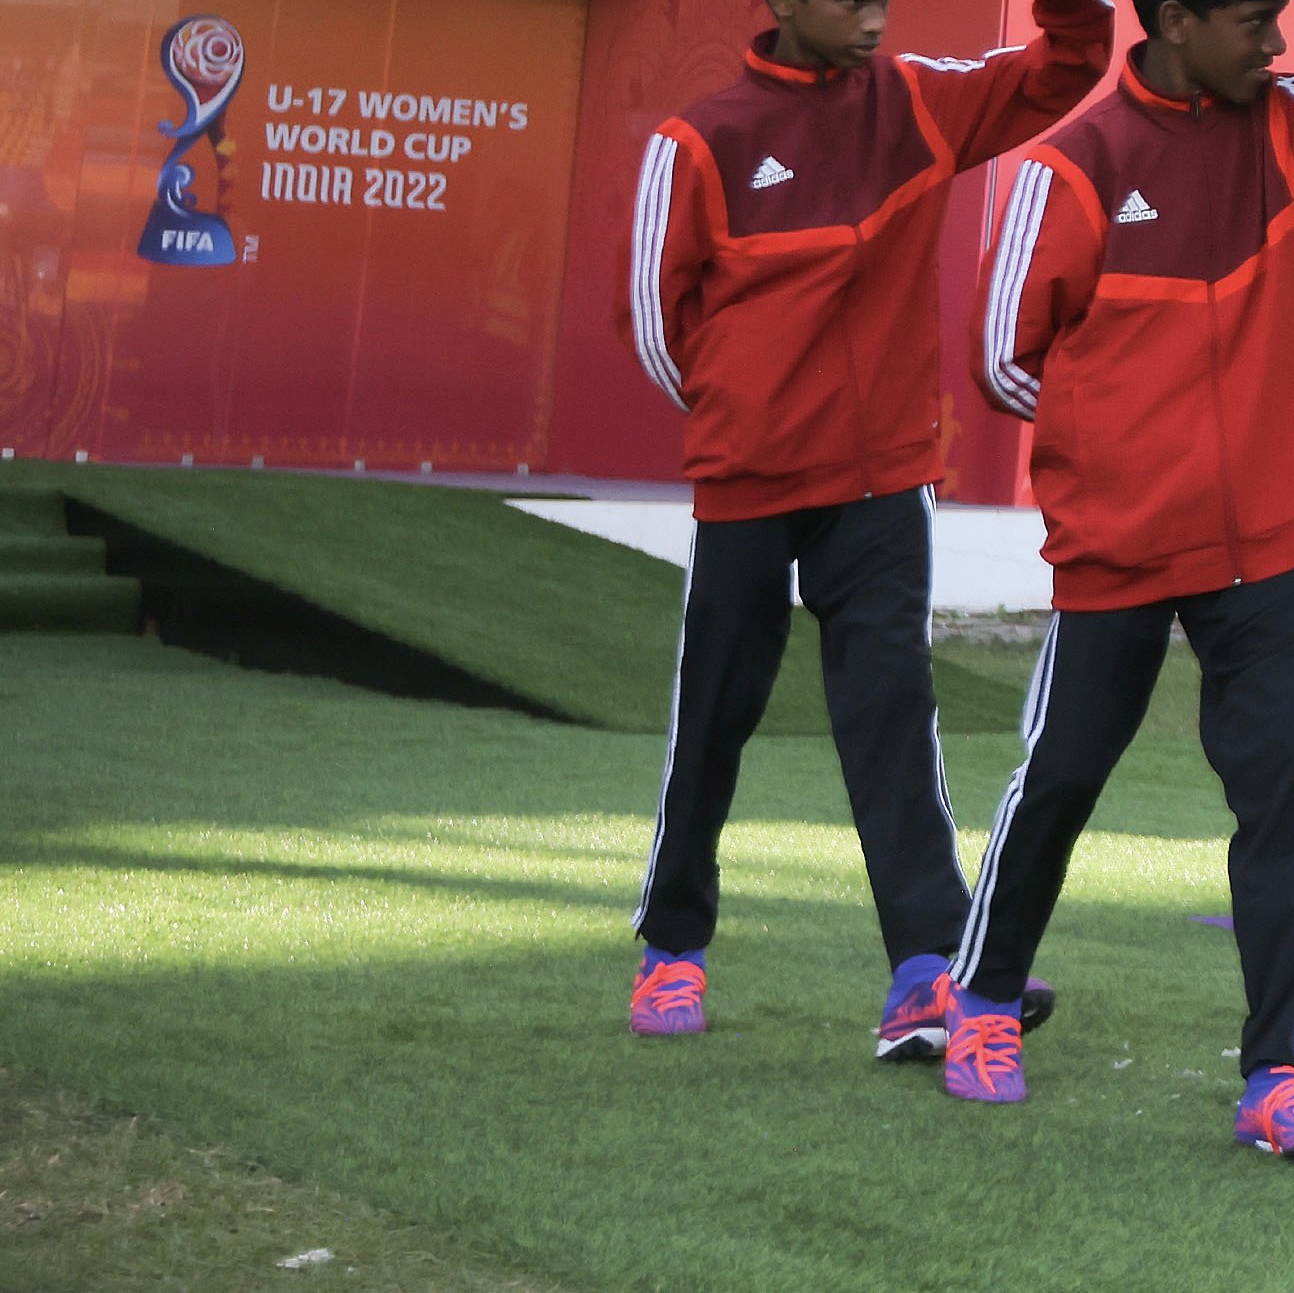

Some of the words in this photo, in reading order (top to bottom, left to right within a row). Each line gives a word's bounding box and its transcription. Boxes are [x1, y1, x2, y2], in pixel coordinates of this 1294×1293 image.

[268, 84, 347, 117] U-17
[358, 91, 528, 130] WOMEN'S
[265, 122, 396, 158] WORLD
[403, 133, 472, 163] CUP
[261, 161, 353, 205] INDIA
[363, 168, 448, 211] 2022
[753, 169, 794, 189] adidas
[1118, 209, 1159, 224] adidas
[162, 229, 214, 253] FIFA
